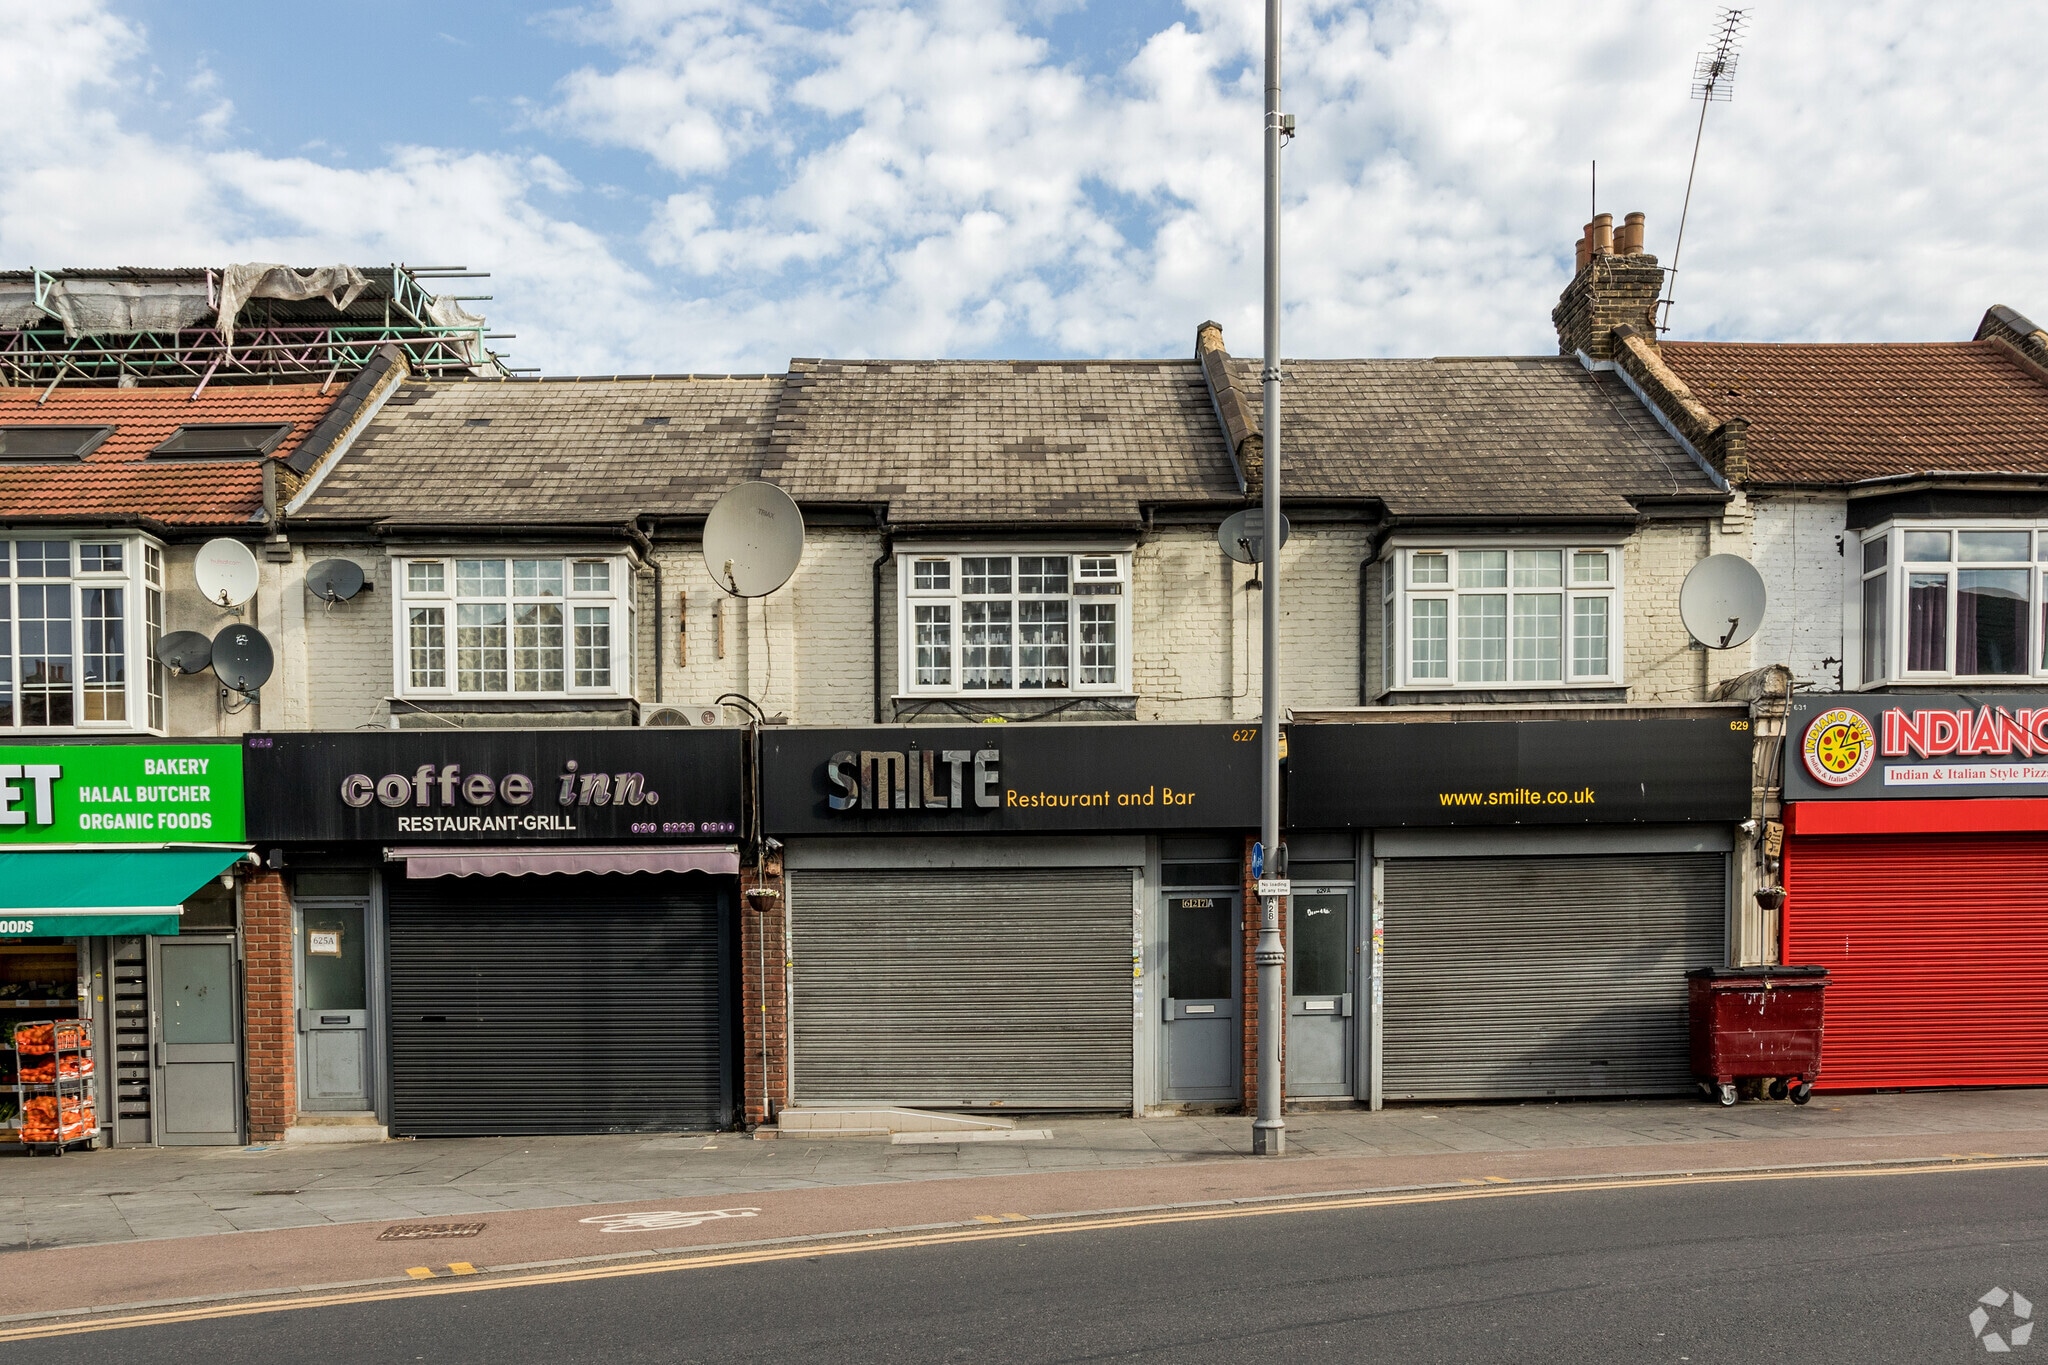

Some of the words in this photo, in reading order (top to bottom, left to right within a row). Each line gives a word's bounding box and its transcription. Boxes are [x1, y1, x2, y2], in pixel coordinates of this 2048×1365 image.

[1730, 721, 1749, 731] 629
[1805, 711, 1846, 753] INDIANO
[1849, 715, 1873, 750] PIZZA
[1232, 729, 1257, 742] 627
[144, 758, 210, 775] BAKERY
[1810, 755, 1822, 774] Indian
[1828, 774, 1848, 783] Italian
[1848, 767, 1861, 779] Style
[1859, 750, 1869, 767] Pizza
[1890, 769, 1929, 780] Indian
[1932, 769, 1943, 780] &
[1948, 769, 1987, 779] Italian
[1989, 768, 2019, 781] Style
[2023, 767, 2048, 778] Pizz
[340, 763, 534, 808] coffee
[558, 759, 660, 807] inn.
[0, 764, 62, 825] ET
[79, 786, 133, 803] HALAL
[136, 785, 211, 802] BUTCHER
[1006, 789, 1110, 808] Restaurant
[1117, 785, 1154, 806] and
[1162, 787, 1196, 806] Bar
[1439, 787, 1595, 806] www.smilte.co.uk
[79, 813, 154, 830] ORGANIC
[157, 812, 212, 829] FOODS
[631, 823, 657, 834] 020
[662, 822, 696, 833] 8223
[700, 821, 735, 833] 0800
[1182, 899, 1214, 908] 627A
[0, 920, 34, 933] OODS
[313, 936, 334, 945] 625A
[131, 1051, 137, 1061] 7
